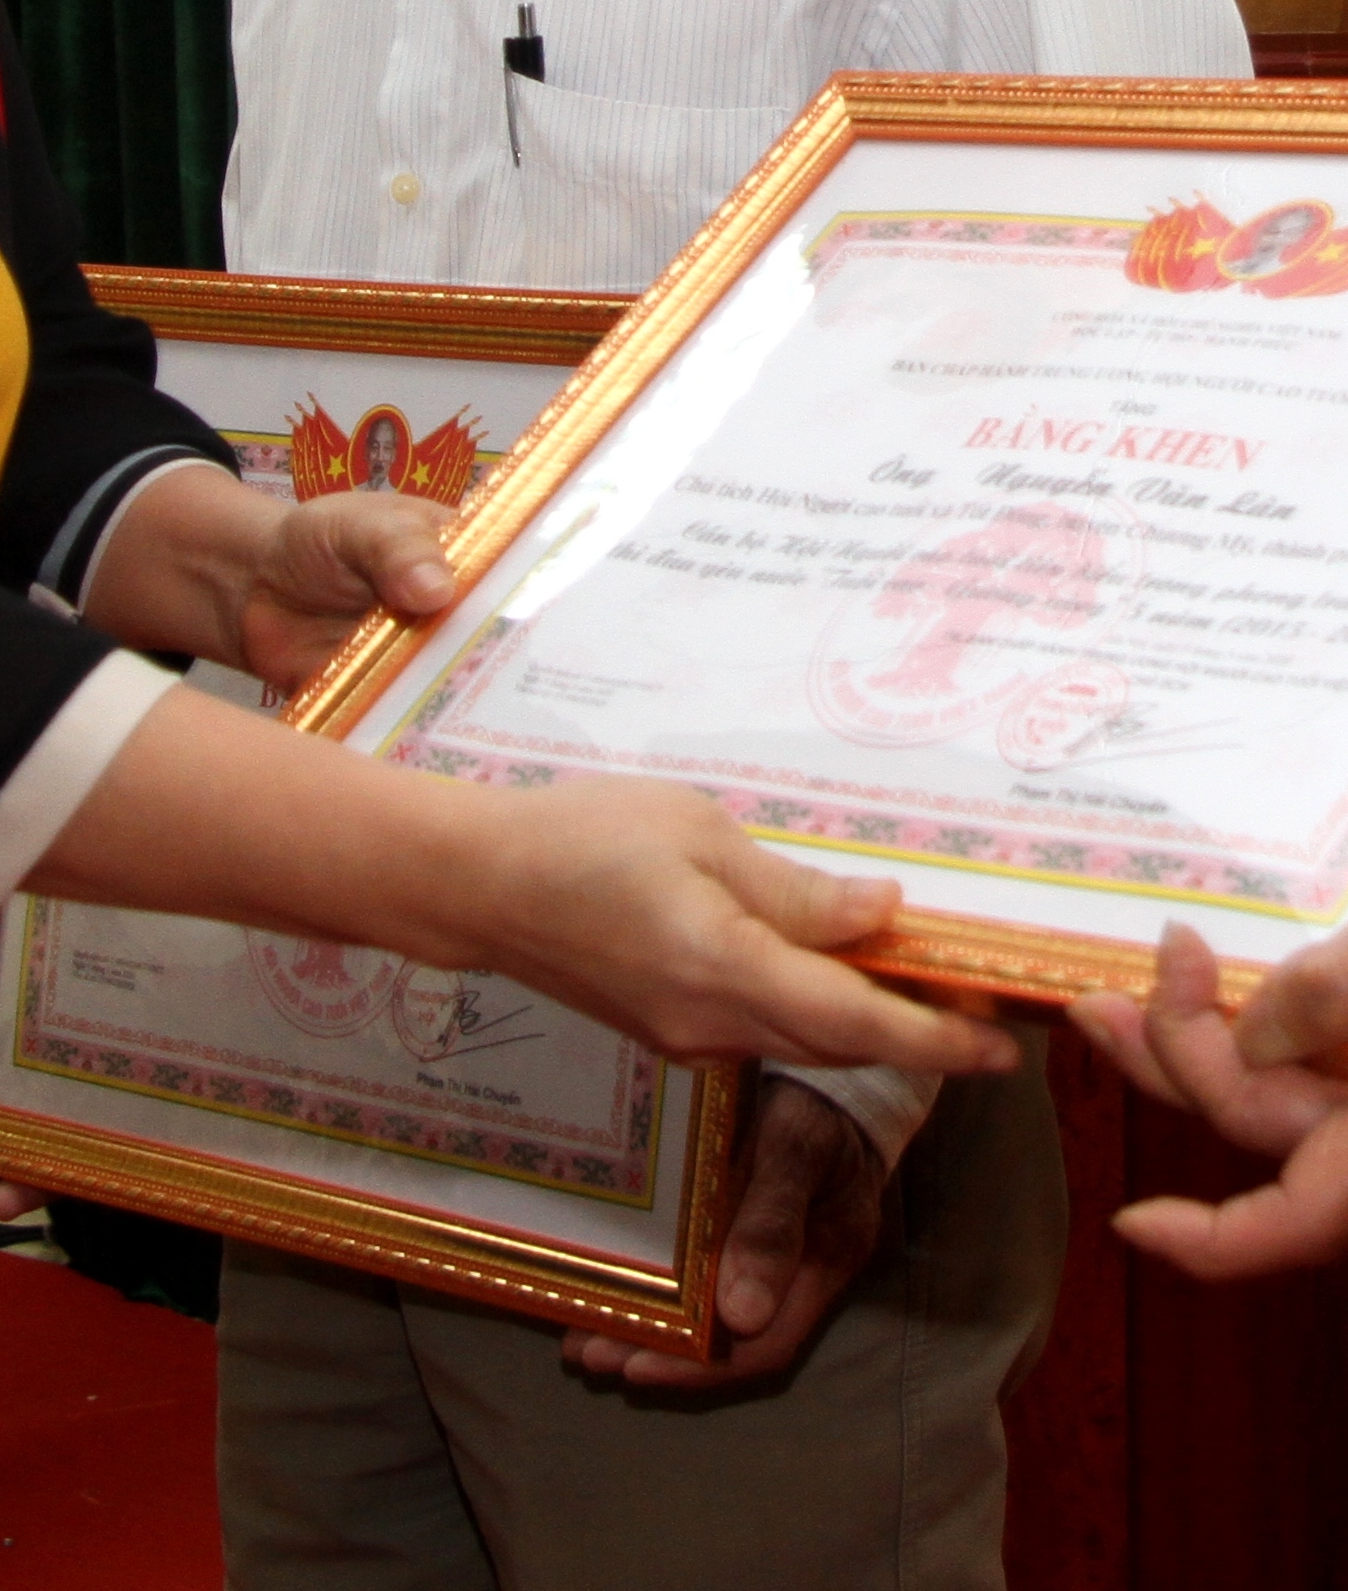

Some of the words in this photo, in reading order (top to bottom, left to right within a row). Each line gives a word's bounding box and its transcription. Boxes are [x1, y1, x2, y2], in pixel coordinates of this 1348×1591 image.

[1106, 424, 1267, 472] KHEN
[868, 453, 936, 488] Ông
[974, 460, 1114, 497] Nguyễn
[1128, 476, 1211, 510] Văn
